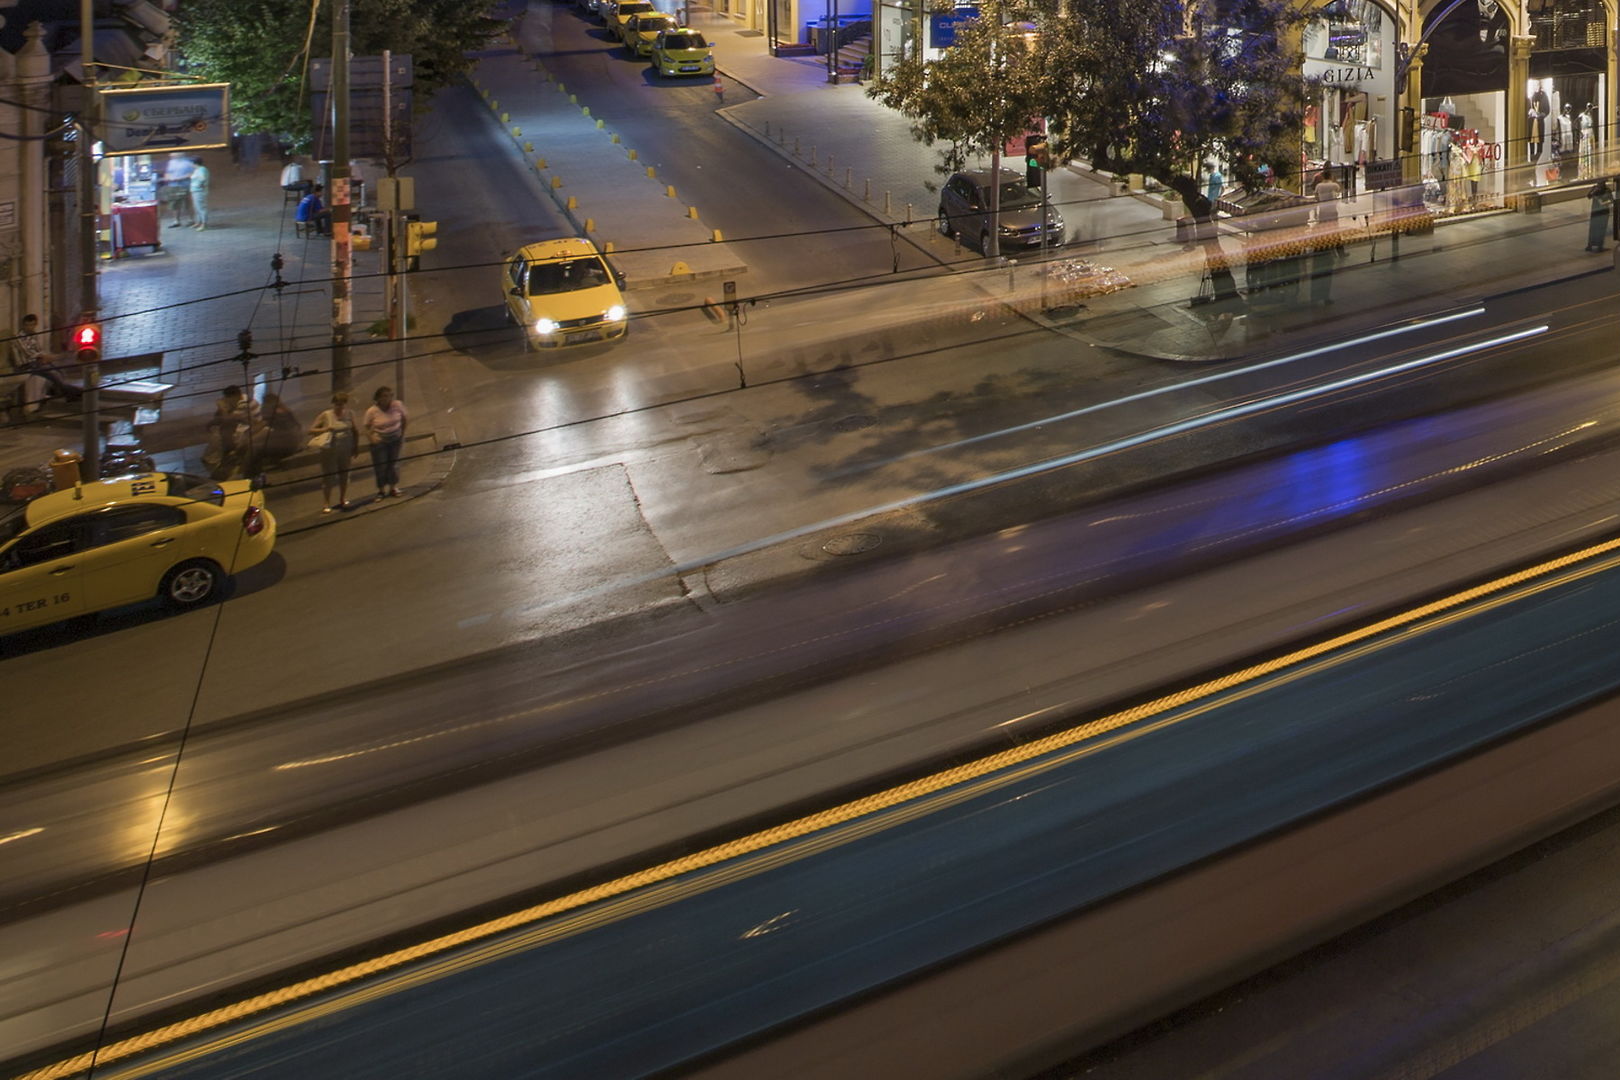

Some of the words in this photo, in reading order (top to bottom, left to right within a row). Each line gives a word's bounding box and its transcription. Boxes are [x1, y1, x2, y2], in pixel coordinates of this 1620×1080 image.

[1324, 67, 1374, 83] GIZIA
[16, 599, 48, 613] TER
[54, 592, 70, 605] 16
